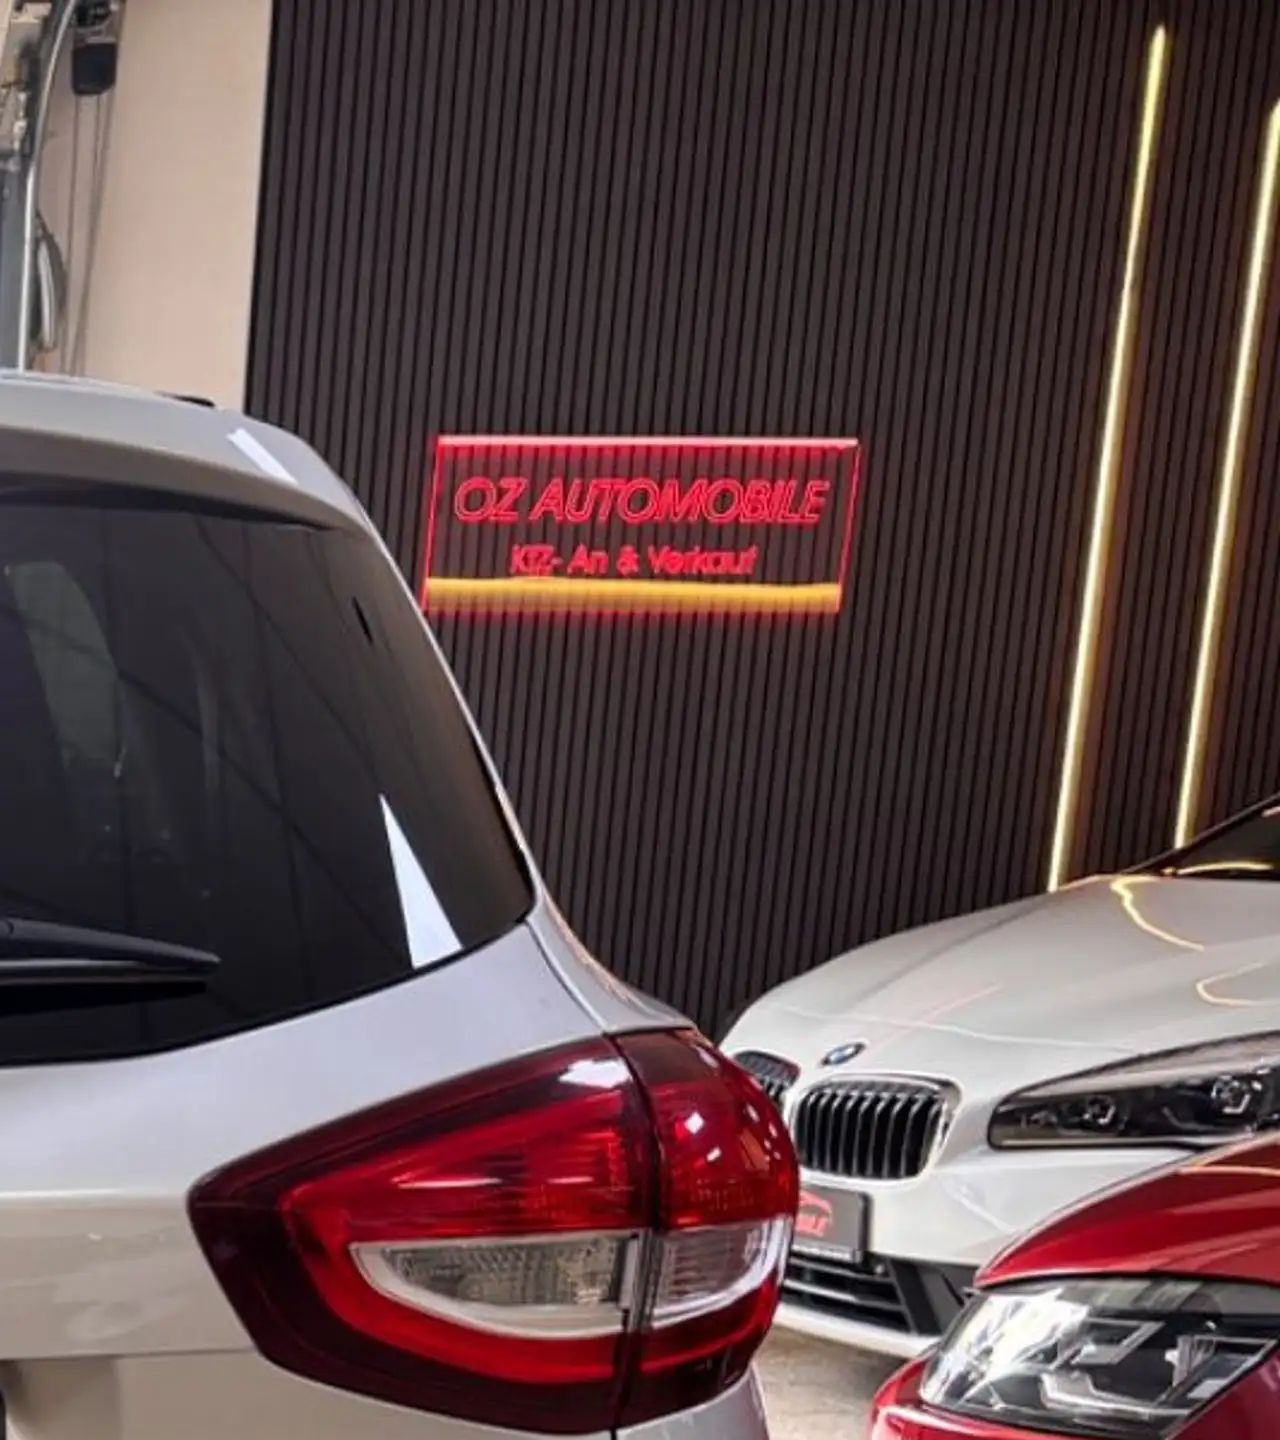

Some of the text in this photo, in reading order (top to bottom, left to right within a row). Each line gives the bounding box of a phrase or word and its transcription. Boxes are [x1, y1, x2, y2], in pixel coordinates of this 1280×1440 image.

[453, 477, 831, 524] OZ AUTOMOBILE
[567, 544, 609, 575] An
[615, 546, 640, 575] &
[647, 544, 759, 575] Verkauf
